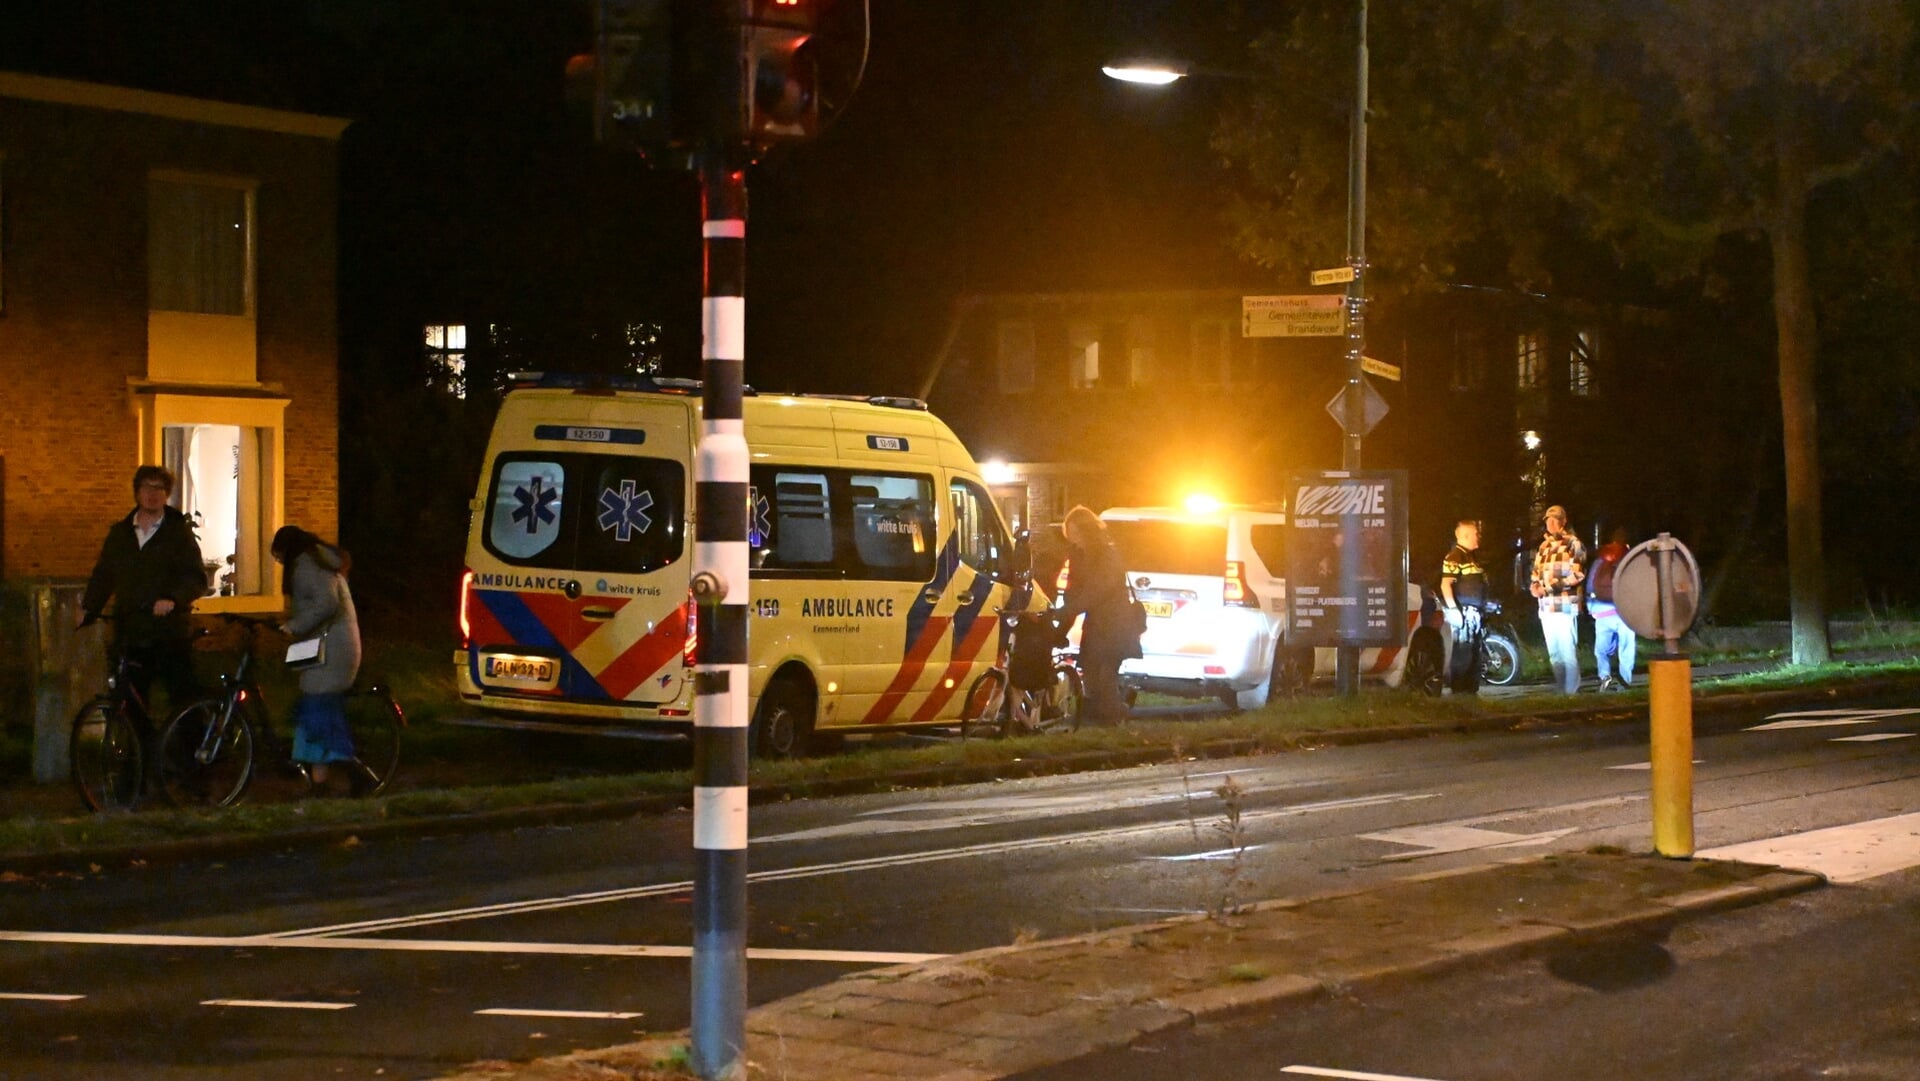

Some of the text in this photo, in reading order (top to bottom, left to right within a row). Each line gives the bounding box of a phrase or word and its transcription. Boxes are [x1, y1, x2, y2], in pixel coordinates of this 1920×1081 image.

[1268, 310, 1340, 321] Gemeentewerf
[1287, 324, 1340, 334] Brandweer
[573, 429, 605, 440] 12-150
[876, 519, 918, 535] witte kruis
[471, 573, 566, 590] AMBULANCE
[609, 584, 661, 597] witte kruis
[801, 597, 894, 617] AMBULANCE
[812, 624, 860, 633] Kennemerland
